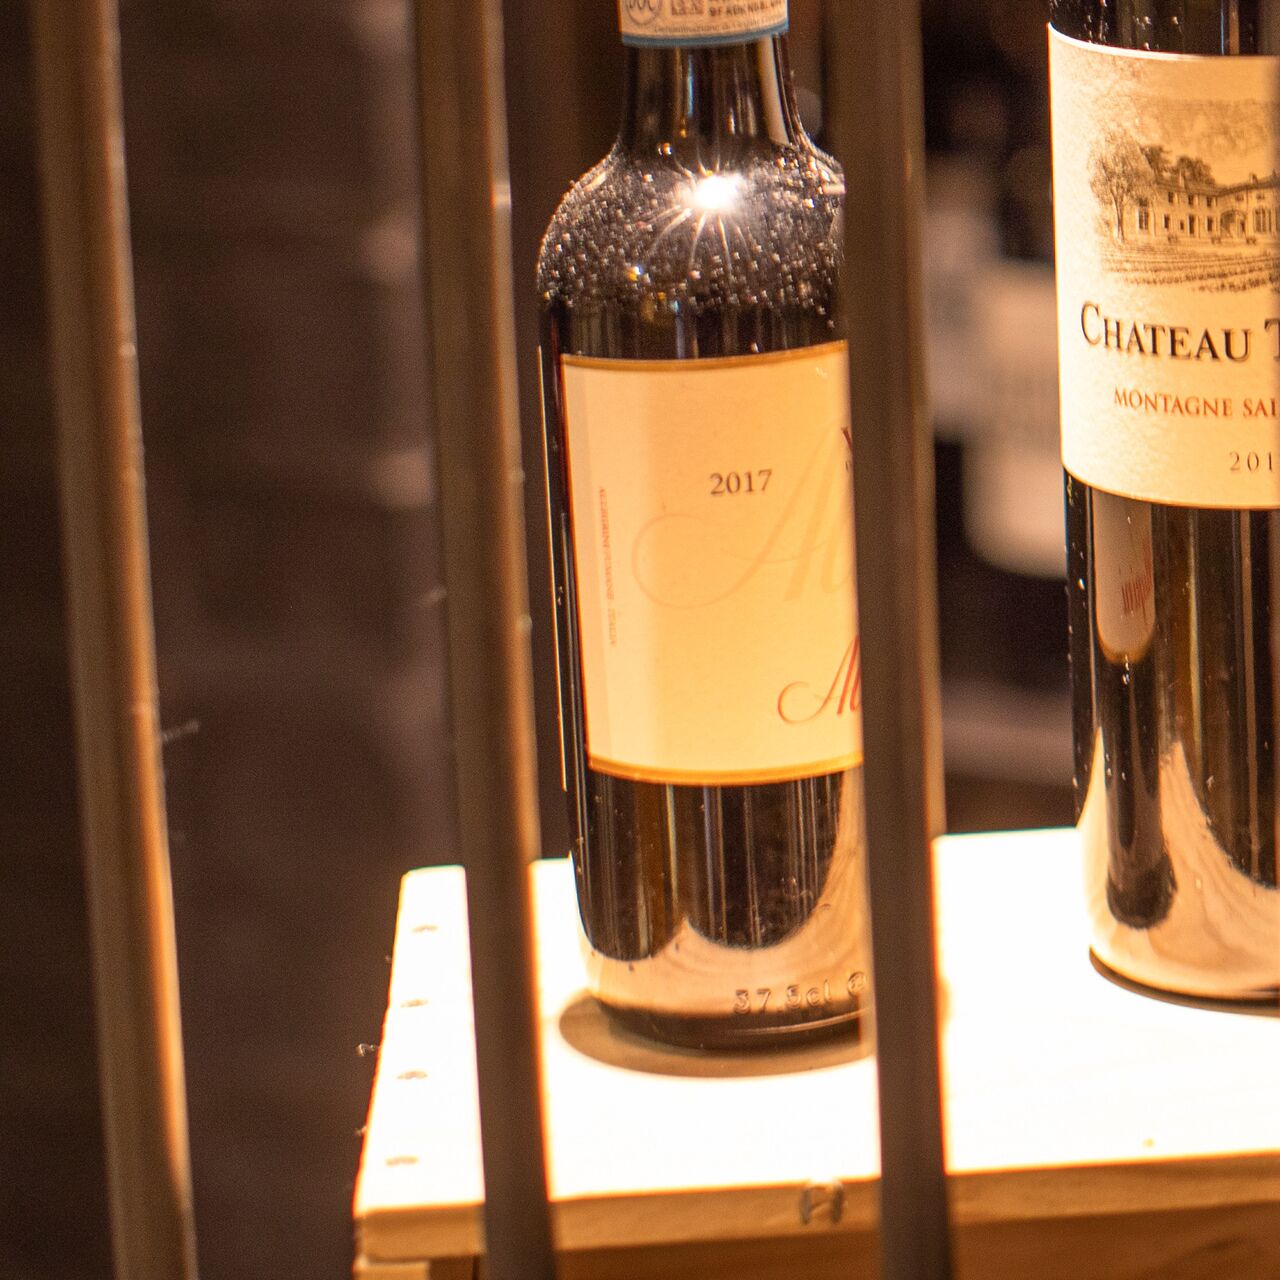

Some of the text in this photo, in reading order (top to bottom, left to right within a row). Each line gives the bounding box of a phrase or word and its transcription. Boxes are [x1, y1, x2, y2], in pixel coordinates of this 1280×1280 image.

[1081, 301, 1252, 363] CHATEAU
[1114, 387, 1233, 417] MONTAGNE
[709, 468, 773, 497] 2017
